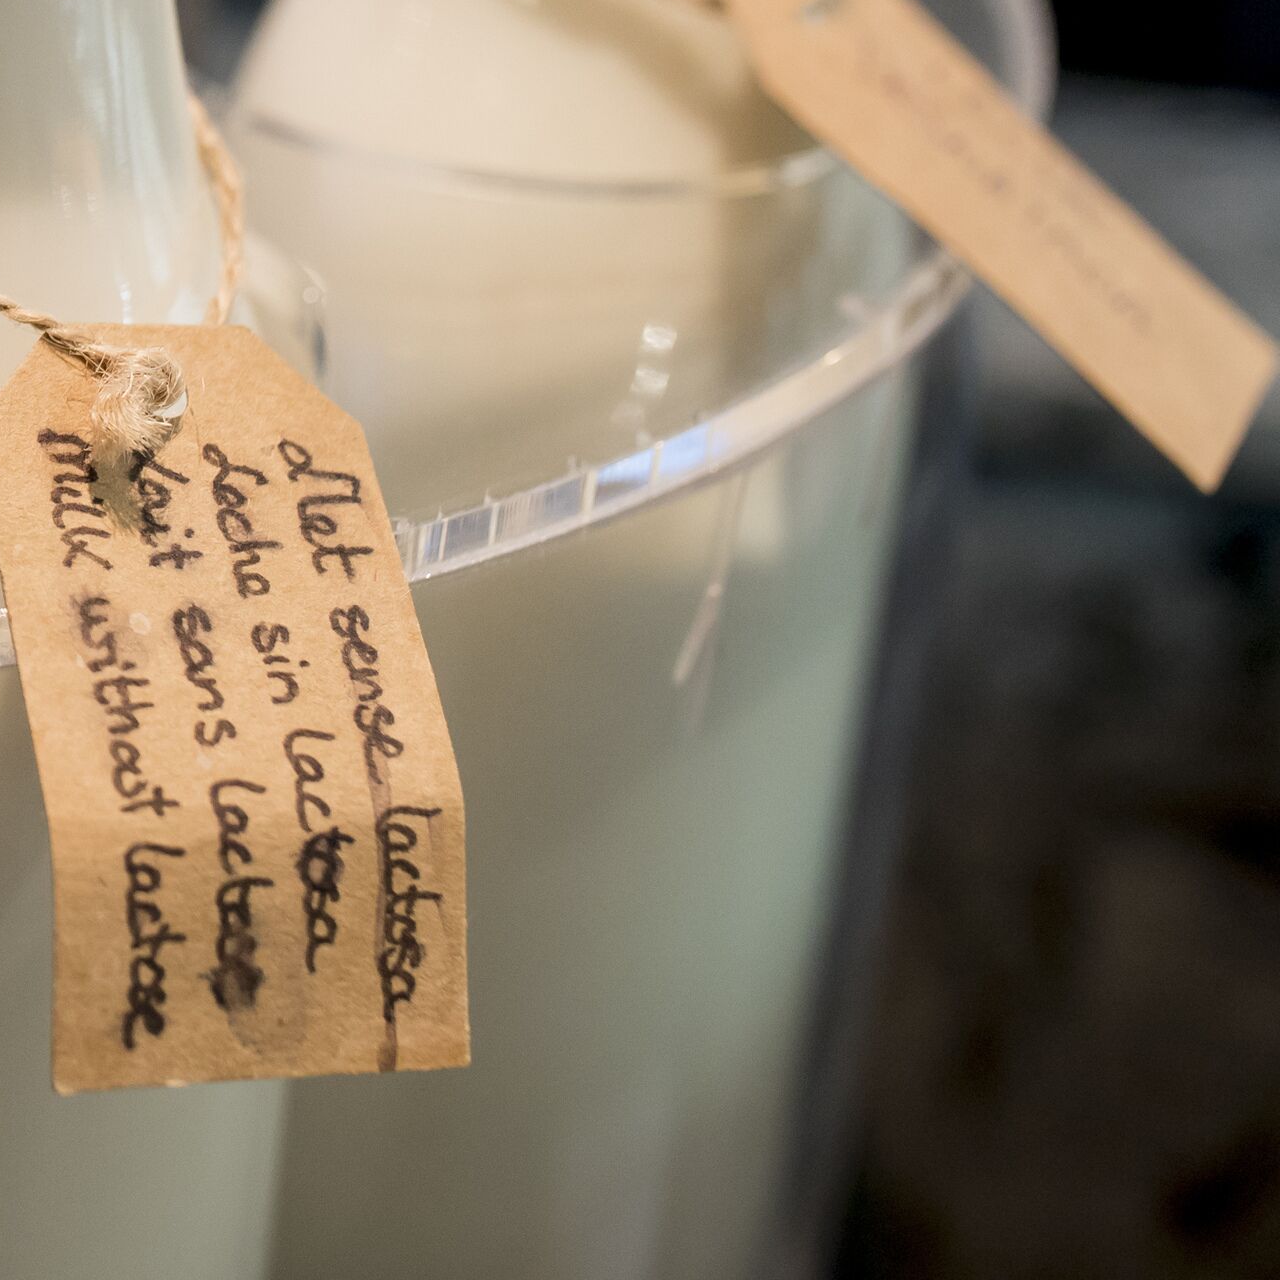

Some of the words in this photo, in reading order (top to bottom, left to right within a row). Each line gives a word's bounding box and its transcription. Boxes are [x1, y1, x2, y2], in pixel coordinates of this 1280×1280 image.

[127, 446, 203, 570] Lait
[76, 595, 179, 818] without
[171, 604, 238, 747] sans
[201, 444, 284, 597] Leche
[250, 622, 309, 705] sin
[283, 729, 354, 974] lactosa
[204, 780, 273, 1012] lactose
[327, 606, 404, 785] sense
[376, 805, 441, 1024] lactosa
[121, 842, 186, 1050] lactose
